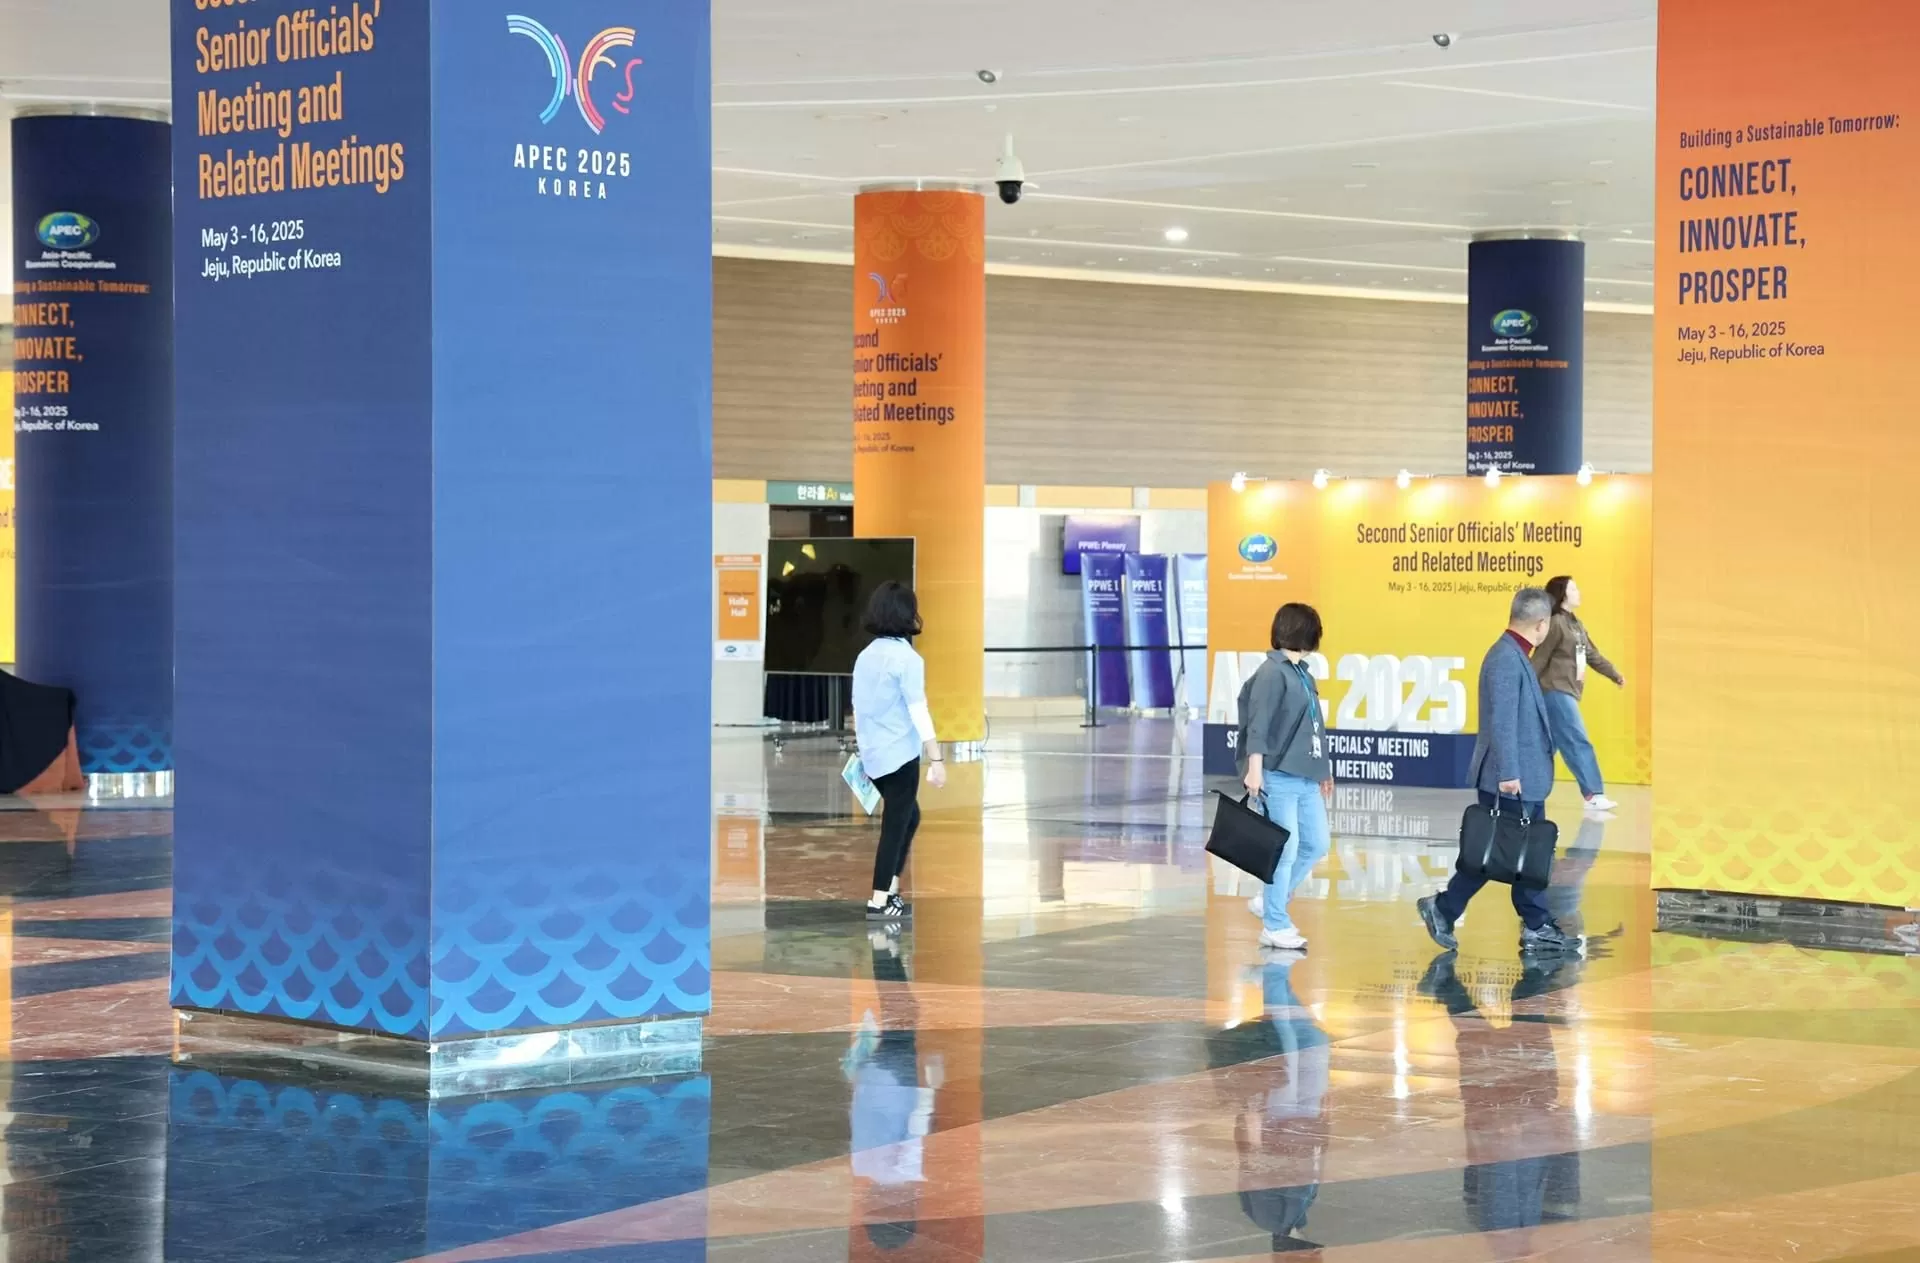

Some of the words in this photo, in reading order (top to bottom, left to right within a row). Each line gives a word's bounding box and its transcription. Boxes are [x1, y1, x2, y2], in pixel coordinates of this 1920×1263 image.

[196, 20, 271, 73] Senior
[197, 81, 292, 138] Meeting
[298, 70, 343, 124] and
[1680, 130, 1732, 149] Building
[1736, 132, 1743, 144] a
[1747, 118, 1824, 142] Sustainable
[1828, 113, 1900, 135] Tomorrow:
[199, 143, 285, 200] Related
[291, 135, 405, 194] Meetings
[513, 143, 567, 172] APEC
[578, 149, 632, 177] 2025
[538, 176, 607, 200] KOREA
[1680, 158, 1797, 201] CONNECT,
[49, 225, 82, 236] APEC
[201, 227, 228, 251] May
[230, 225, 239, 245] 3
[250, 223, 269, 245] 16,
[271, 219, 304, 242] 2025
[1680, 211, 1806, 253] INNOVATE,
[201, 257, 230, 282] Jeju,
[232, 250, 286, 279] Republic
[289, 248, 302, 270] of
[303, 249, 341, 269] Korea
[1679, 265, 1787, 305] PROSPER
[1501, 318, 1525, 328] APEC
[1678, 326, 1706, 344] May
[1708, 324, 1717, 339] 3
[1729, 322, 1749, 340] 16,
[1752, 321, 1786, 337] 2025
[876, 352, 942, 373] Officials'
[1677, 348, 1707, 365] Jeju,
[1710, 343, 1766, 364] Republic
[1769, 342, 1783, 358] of
[1786, 343, 1825, 357] Korea
[888, 377, 917, 397] and
[42, 406, 68, 417] 2025
[883, 402, 955, 426] Meetings
[54, 420, 66, 430] of
[67, 420, 99, 431] Korea
[1494, 451, 1513, 460] 2025
[1503, 461, 1511, 469] of
[1512, 461, 1536, 470] Korea
[1356, 523, 1406, 544] Second
[1410, 522, 1454, 544] Senior
[1457, 521, 1519, 543] Officials'
[1523, 521, 1582, 547] Meeting
[1247, 543, 1268, 553] APEC
[1392, 552, 1417, 572] and
[1422, 551, 1473, 573] Related
[1477, 550, 1544, 577] Meetings
[1088, 580, 1114, 592] PPWE
[1132, 580, 1157, 592] PPWE
[1388, 582, 1405, 593] May
[1432, 582, 1452, 592] 2025
[1477, 581, 1512, 595] Republic
[1336, 653, 1467, 734] 2025
[1378, 737, 1429, 758] MEETING
[1336, 759, 1394, 780] MEETINGS
